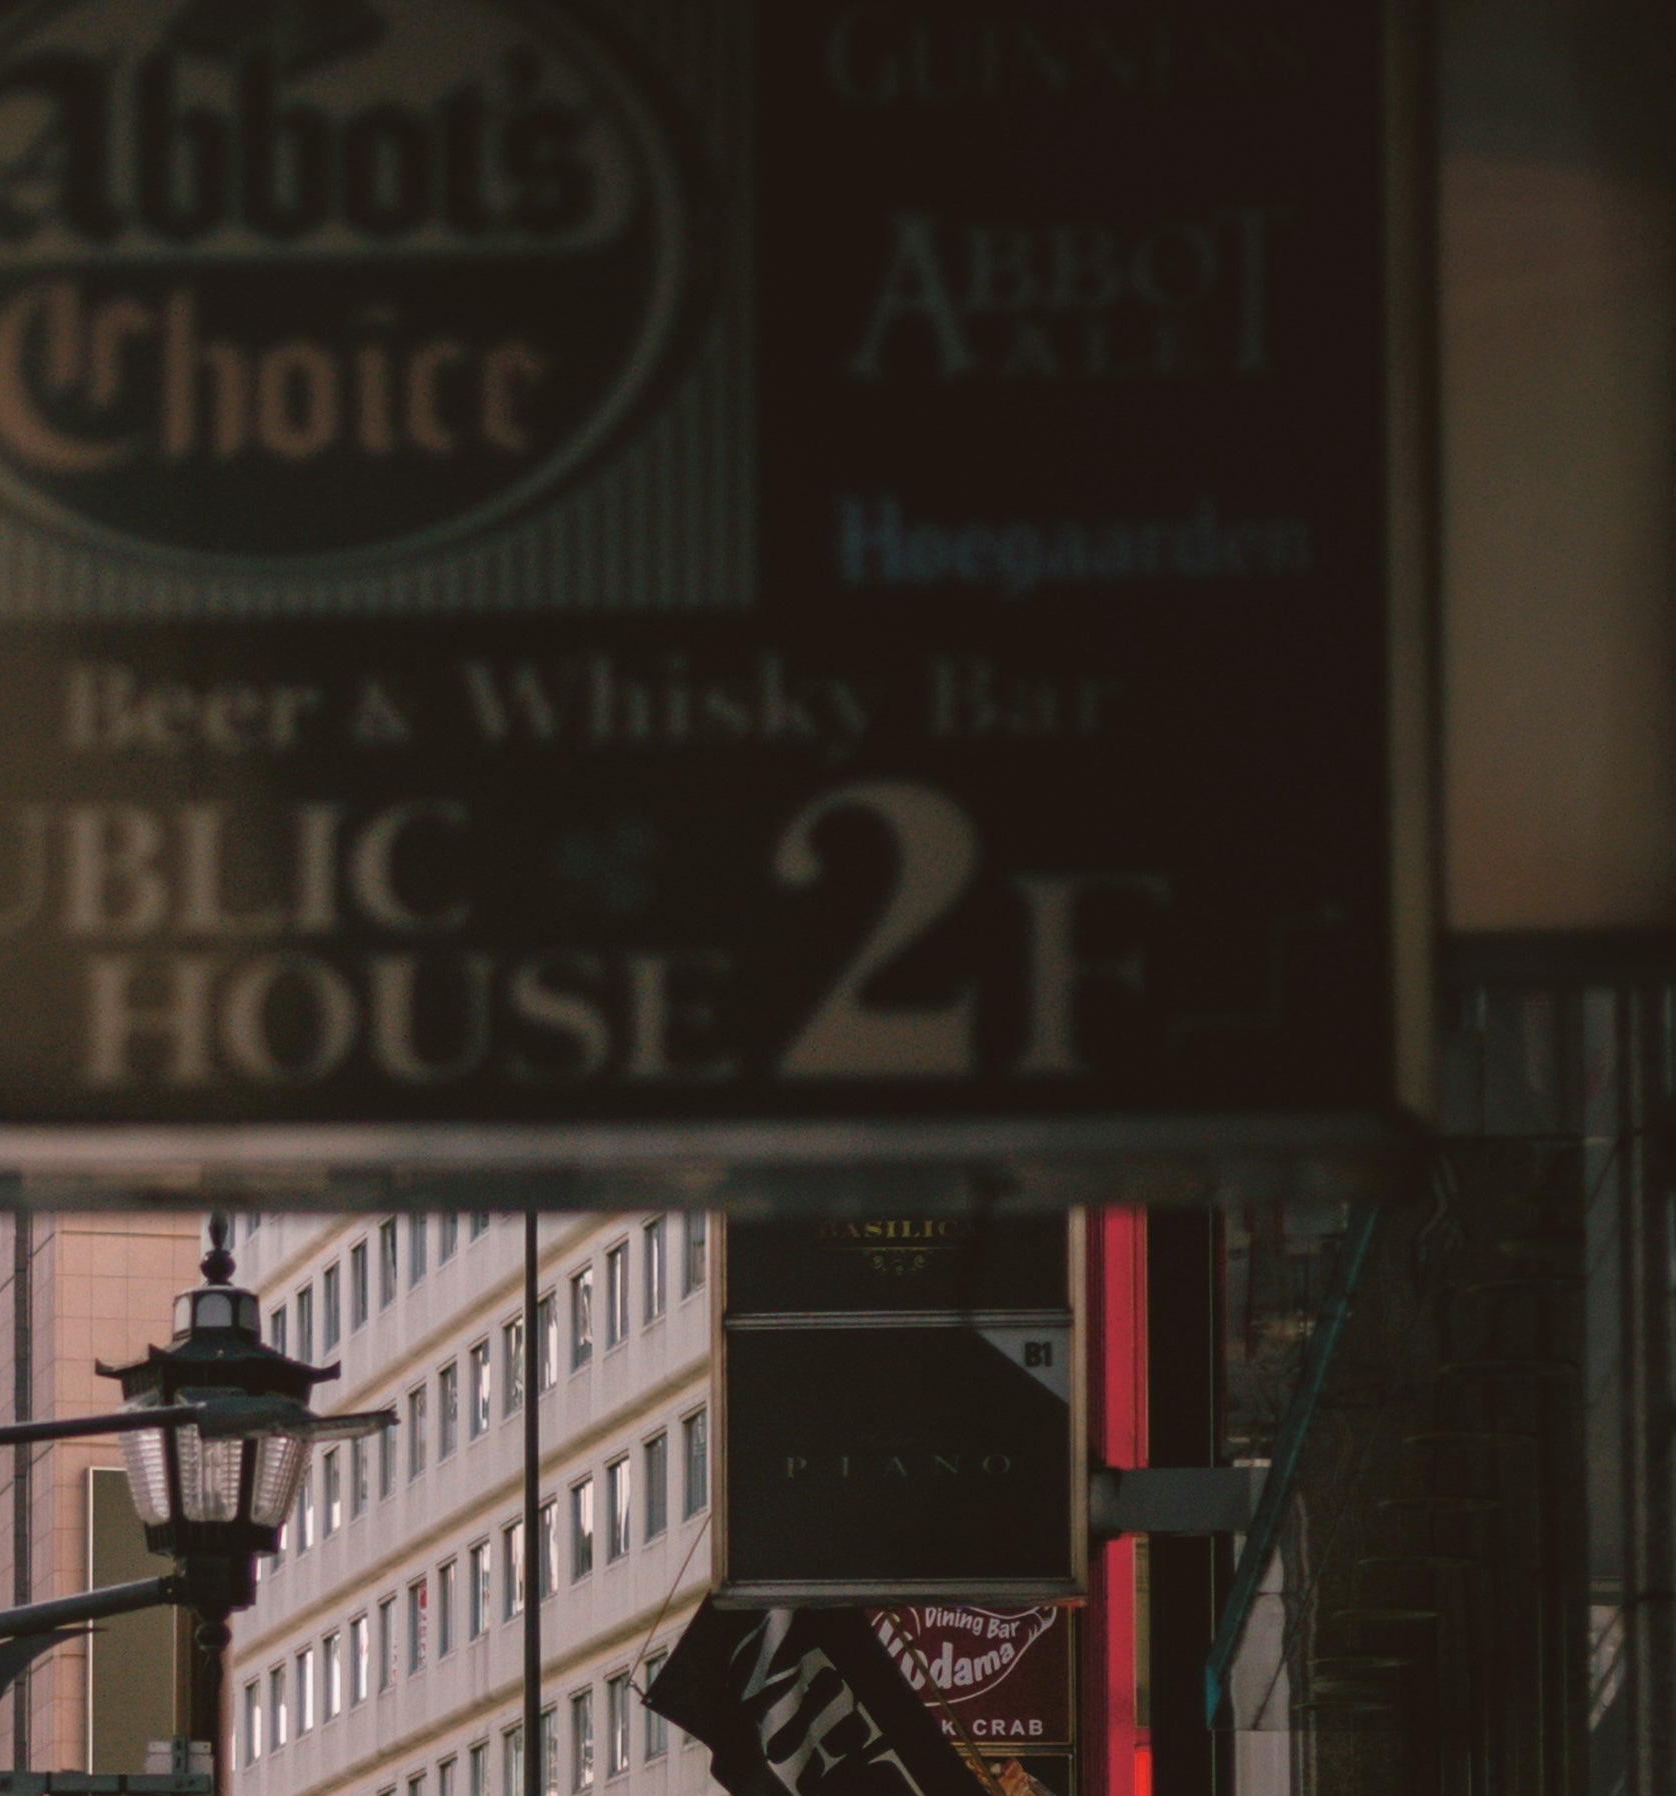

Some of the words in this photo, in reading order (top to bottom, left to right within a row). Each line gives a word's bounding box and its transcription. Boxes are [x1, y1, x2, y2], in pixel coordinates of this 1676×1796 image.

[60, 660, 319, 752] Beer
[463, 652, 879, 758] Whisky
[83, 950, 739, 1088] HOUSE
[1024, 1341, 1053, 1367] B1
[785, 1454, 1012, 1479] PIANO
[925, 1606, 984, 1637] Dining
[986, 1618, 1021, 1639] Bar
[972, 1719, 1044, 1736] CRAB
